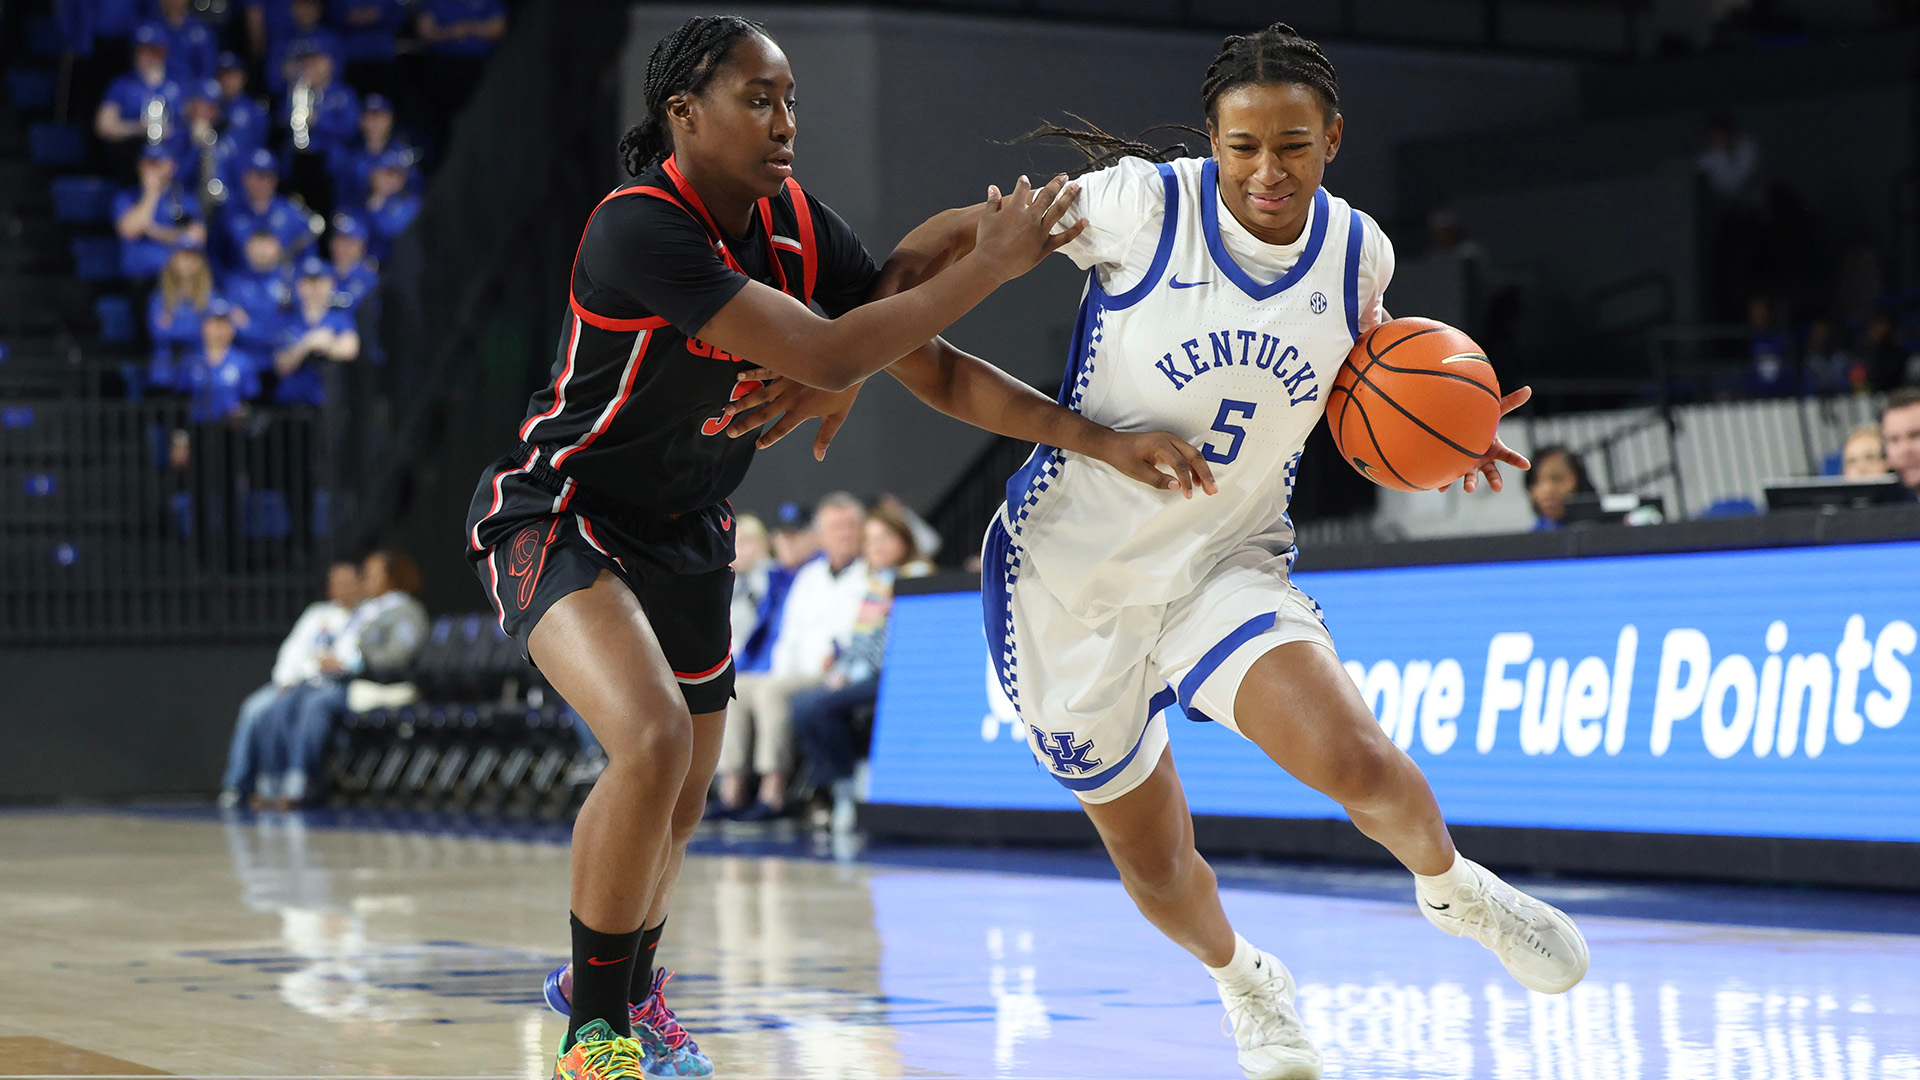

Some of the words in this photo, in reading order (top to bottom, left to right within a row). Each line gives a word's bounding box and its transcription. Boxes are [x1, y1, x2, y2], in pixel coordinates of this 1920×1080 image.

[1310, 292, 1327, 314] SEC
[1155, 330, 1318, 407] KENTUCKY
[1202, 398, 1257, 465] 5
[1476, 623, 1639, 758] Fuel
[1650, 613, 1919, 760] Points
[1030, 724, 1103, 775] UK
